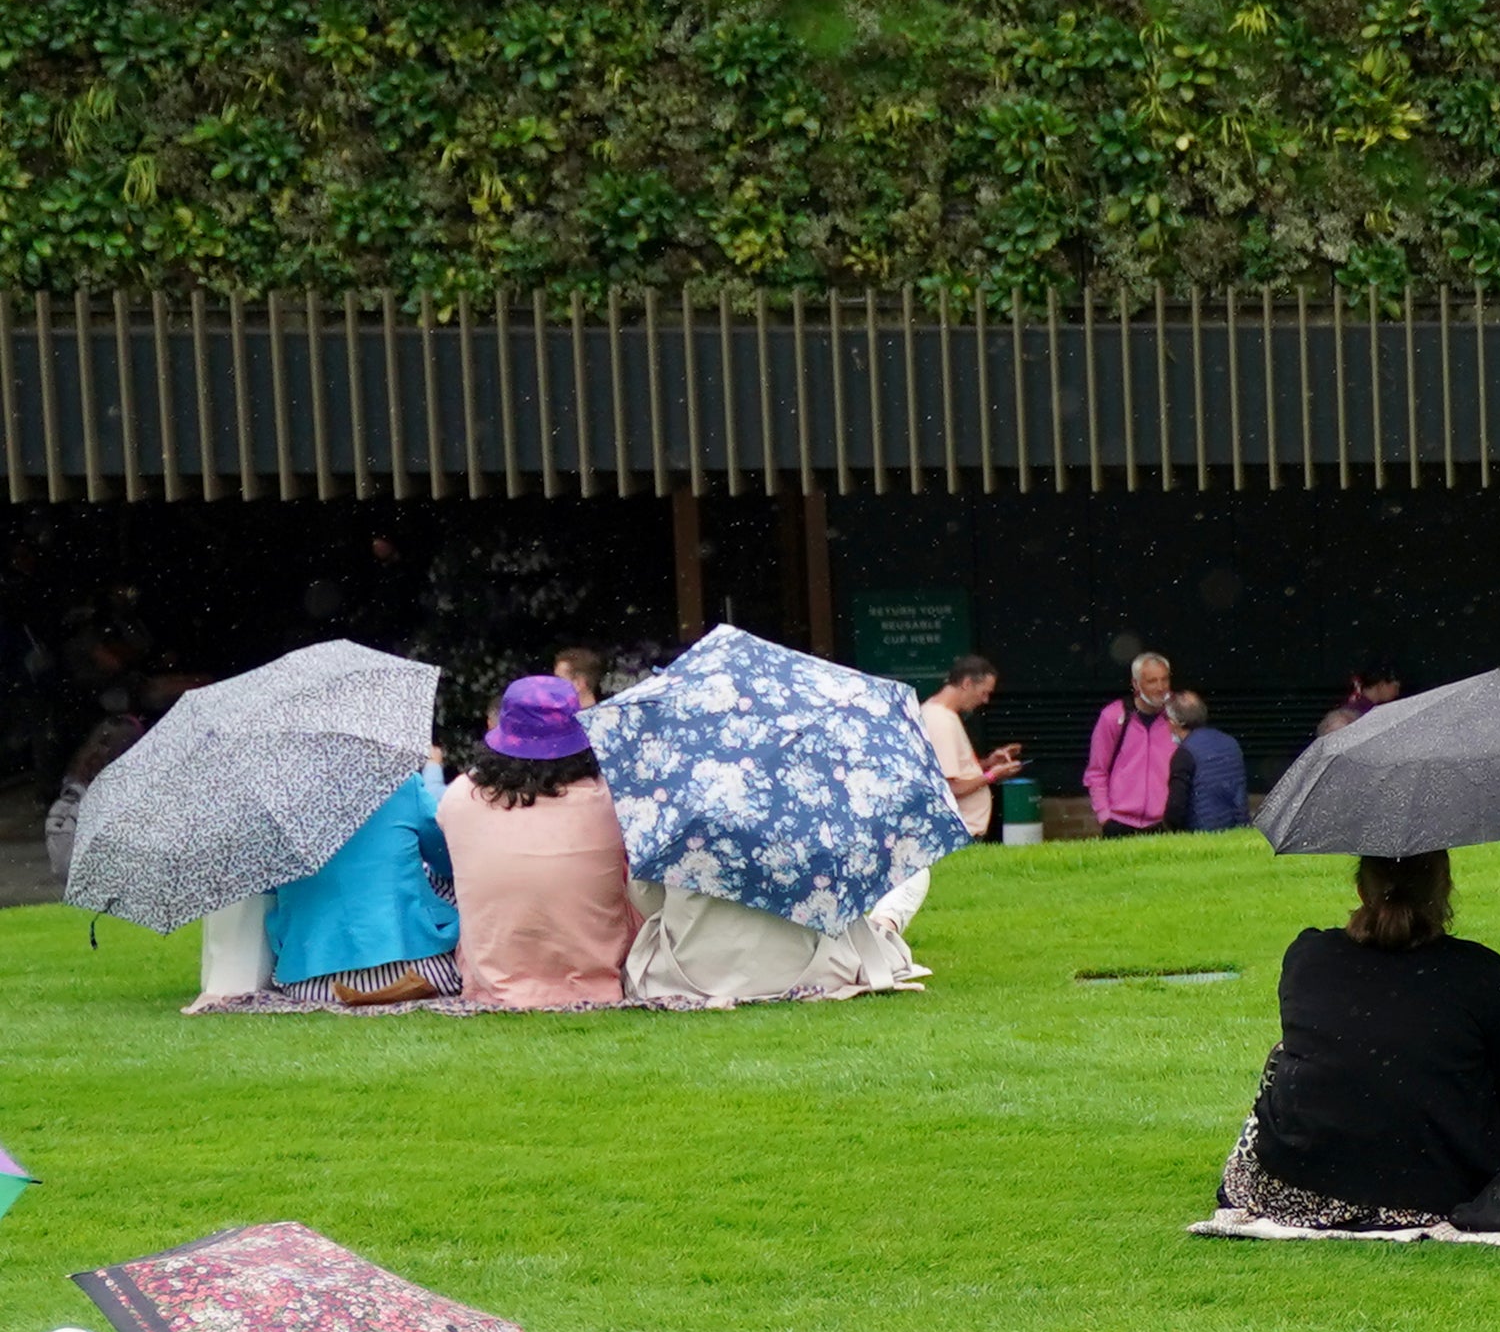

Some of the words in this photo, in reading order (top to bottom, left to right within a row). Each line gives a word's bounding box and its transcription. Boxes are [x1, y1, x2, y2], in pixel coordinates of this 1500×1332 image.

[868, 605, 916, 616] RETURN
[920, 605, 952, 615] YOUR
[881, 620, 941, 630] REUSABLE
[883, 634, 906, 644] CUP
[910, 634, 941, 644] HERE
